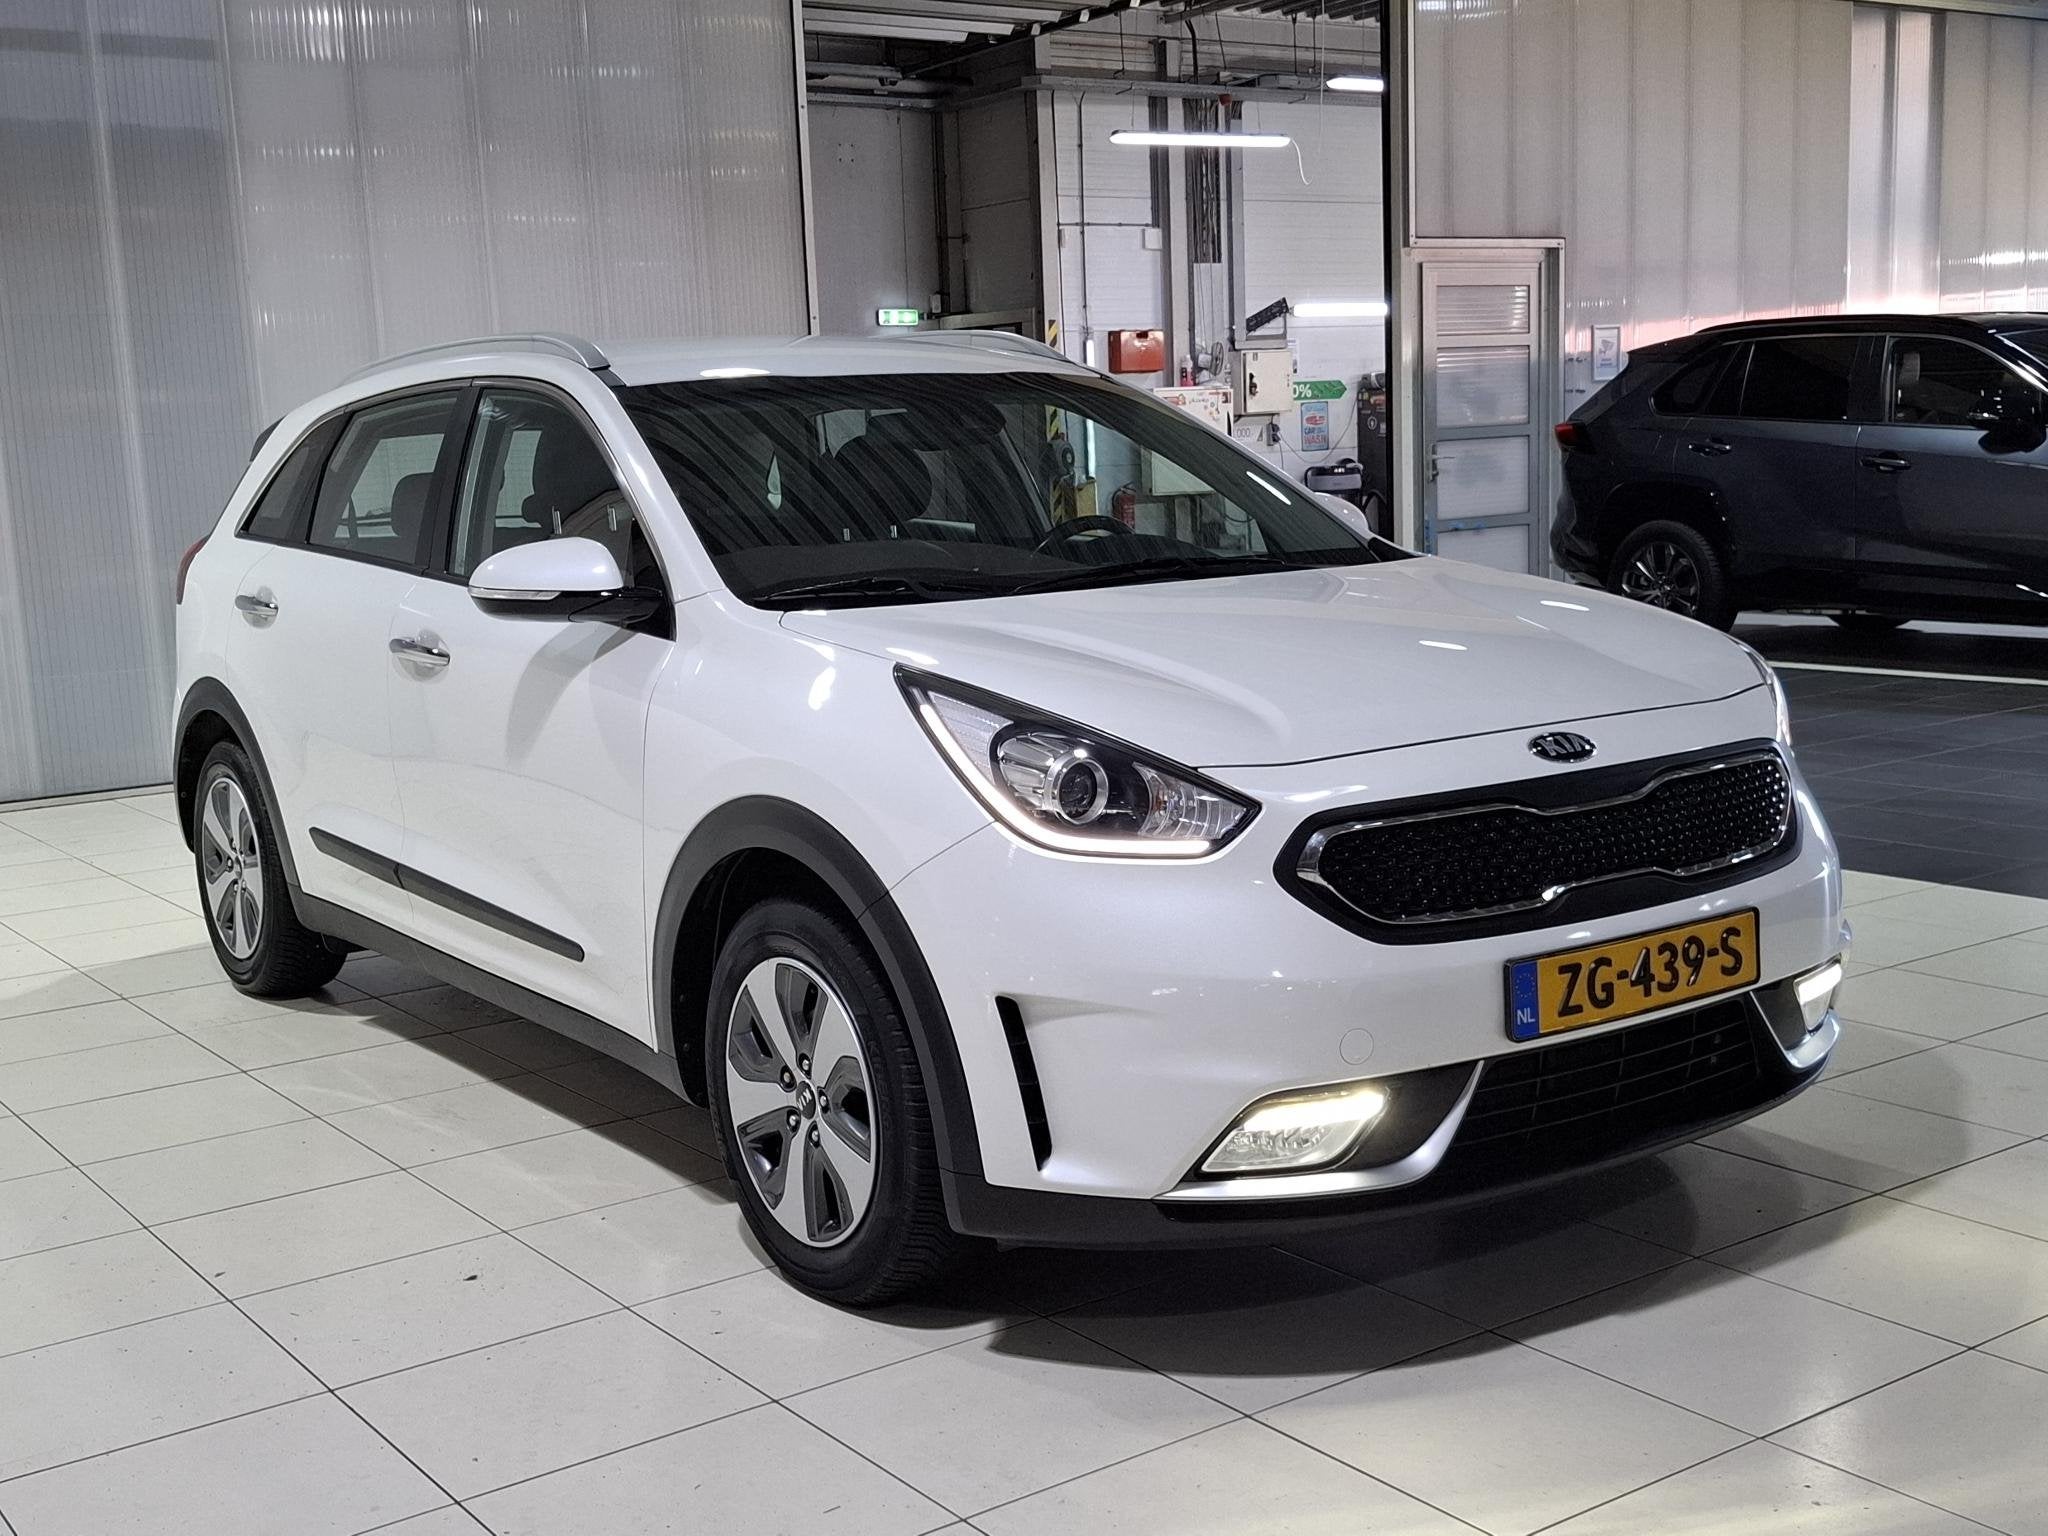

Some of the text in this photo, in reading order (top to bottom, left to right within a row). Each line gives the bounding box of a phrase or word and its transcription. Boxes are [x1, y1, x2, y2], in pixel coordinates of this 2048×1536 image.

[1537, 734, 1590, 756] KIA
[1558, 927, 1743, 1018] ZG-439-S
[1517, 1010, 1536, 1026] NL
[797, 1088, 813, 1112] KIA
